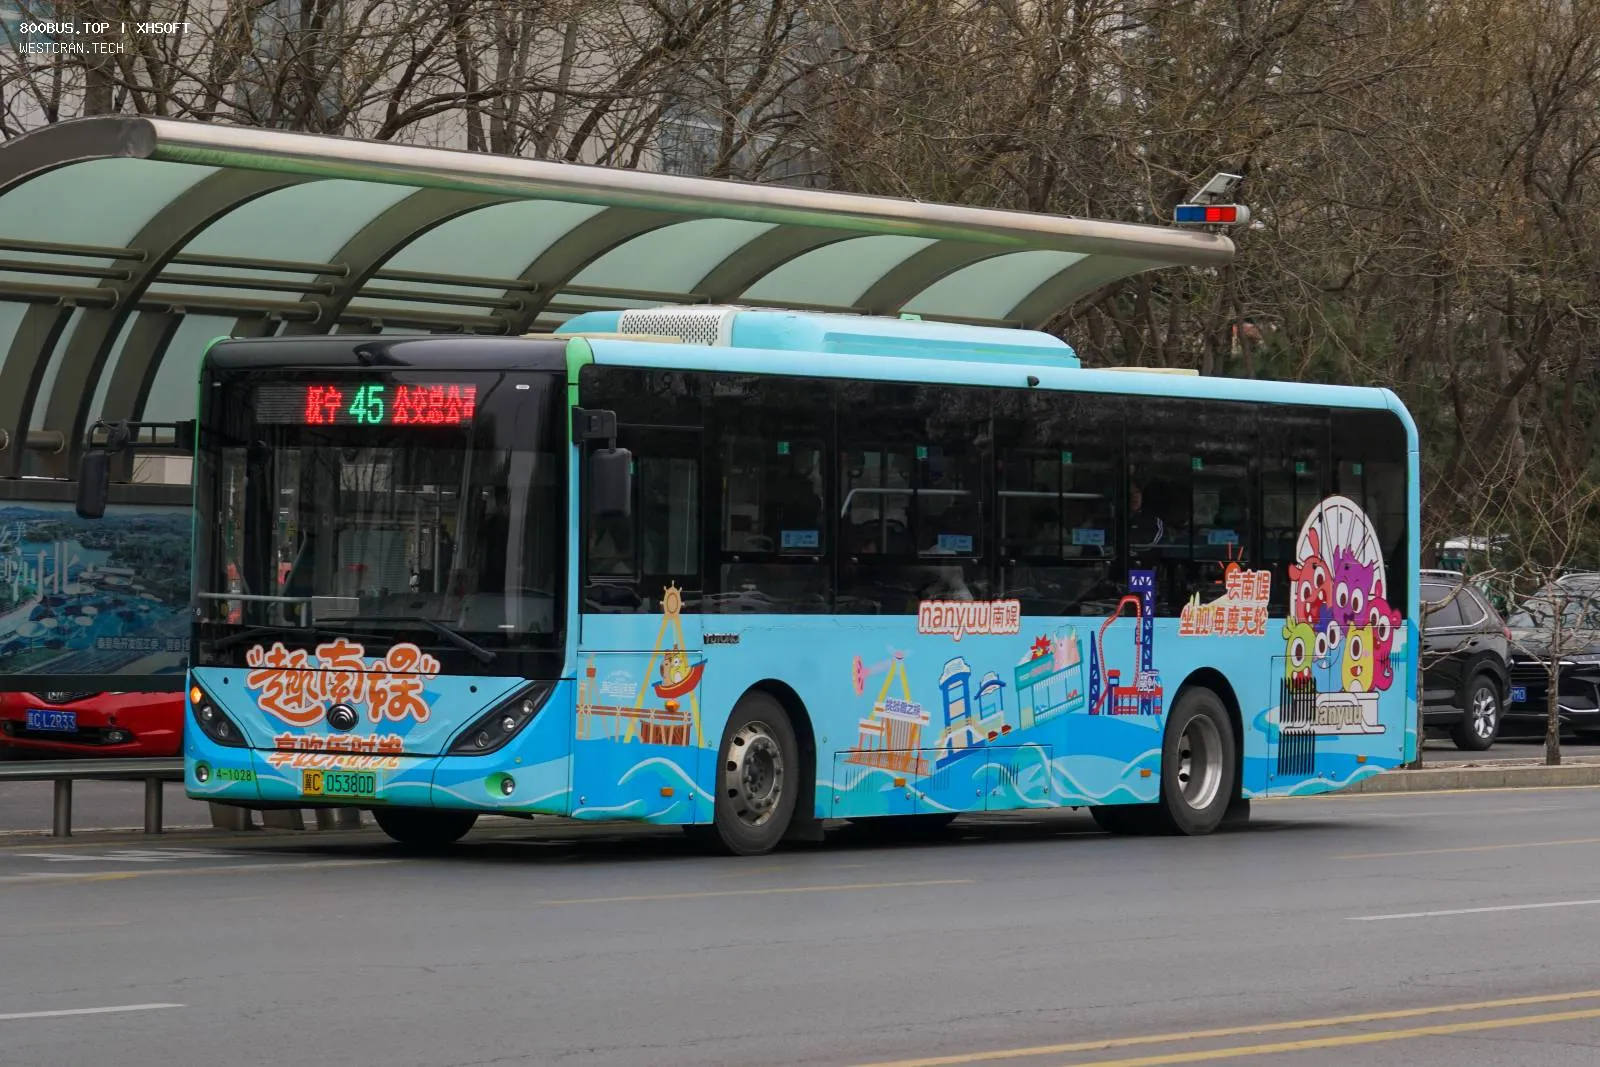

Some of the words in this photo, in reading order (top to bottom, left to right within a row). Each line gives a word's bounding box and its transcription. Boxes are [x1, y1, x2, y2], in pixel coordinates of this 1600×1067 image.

[349, 385, 385, 424] 45
[392, 384, 477, 424] 公交总公司
[1227, 569, 1270, 602] 去南娱
[920, 603, 989, 638] nanyuu
[993, 604, 1018, 627] 南娱
[269, 733, 402, 767] 享欢乐时光
[216, 769, 252, 782] 4-1028
